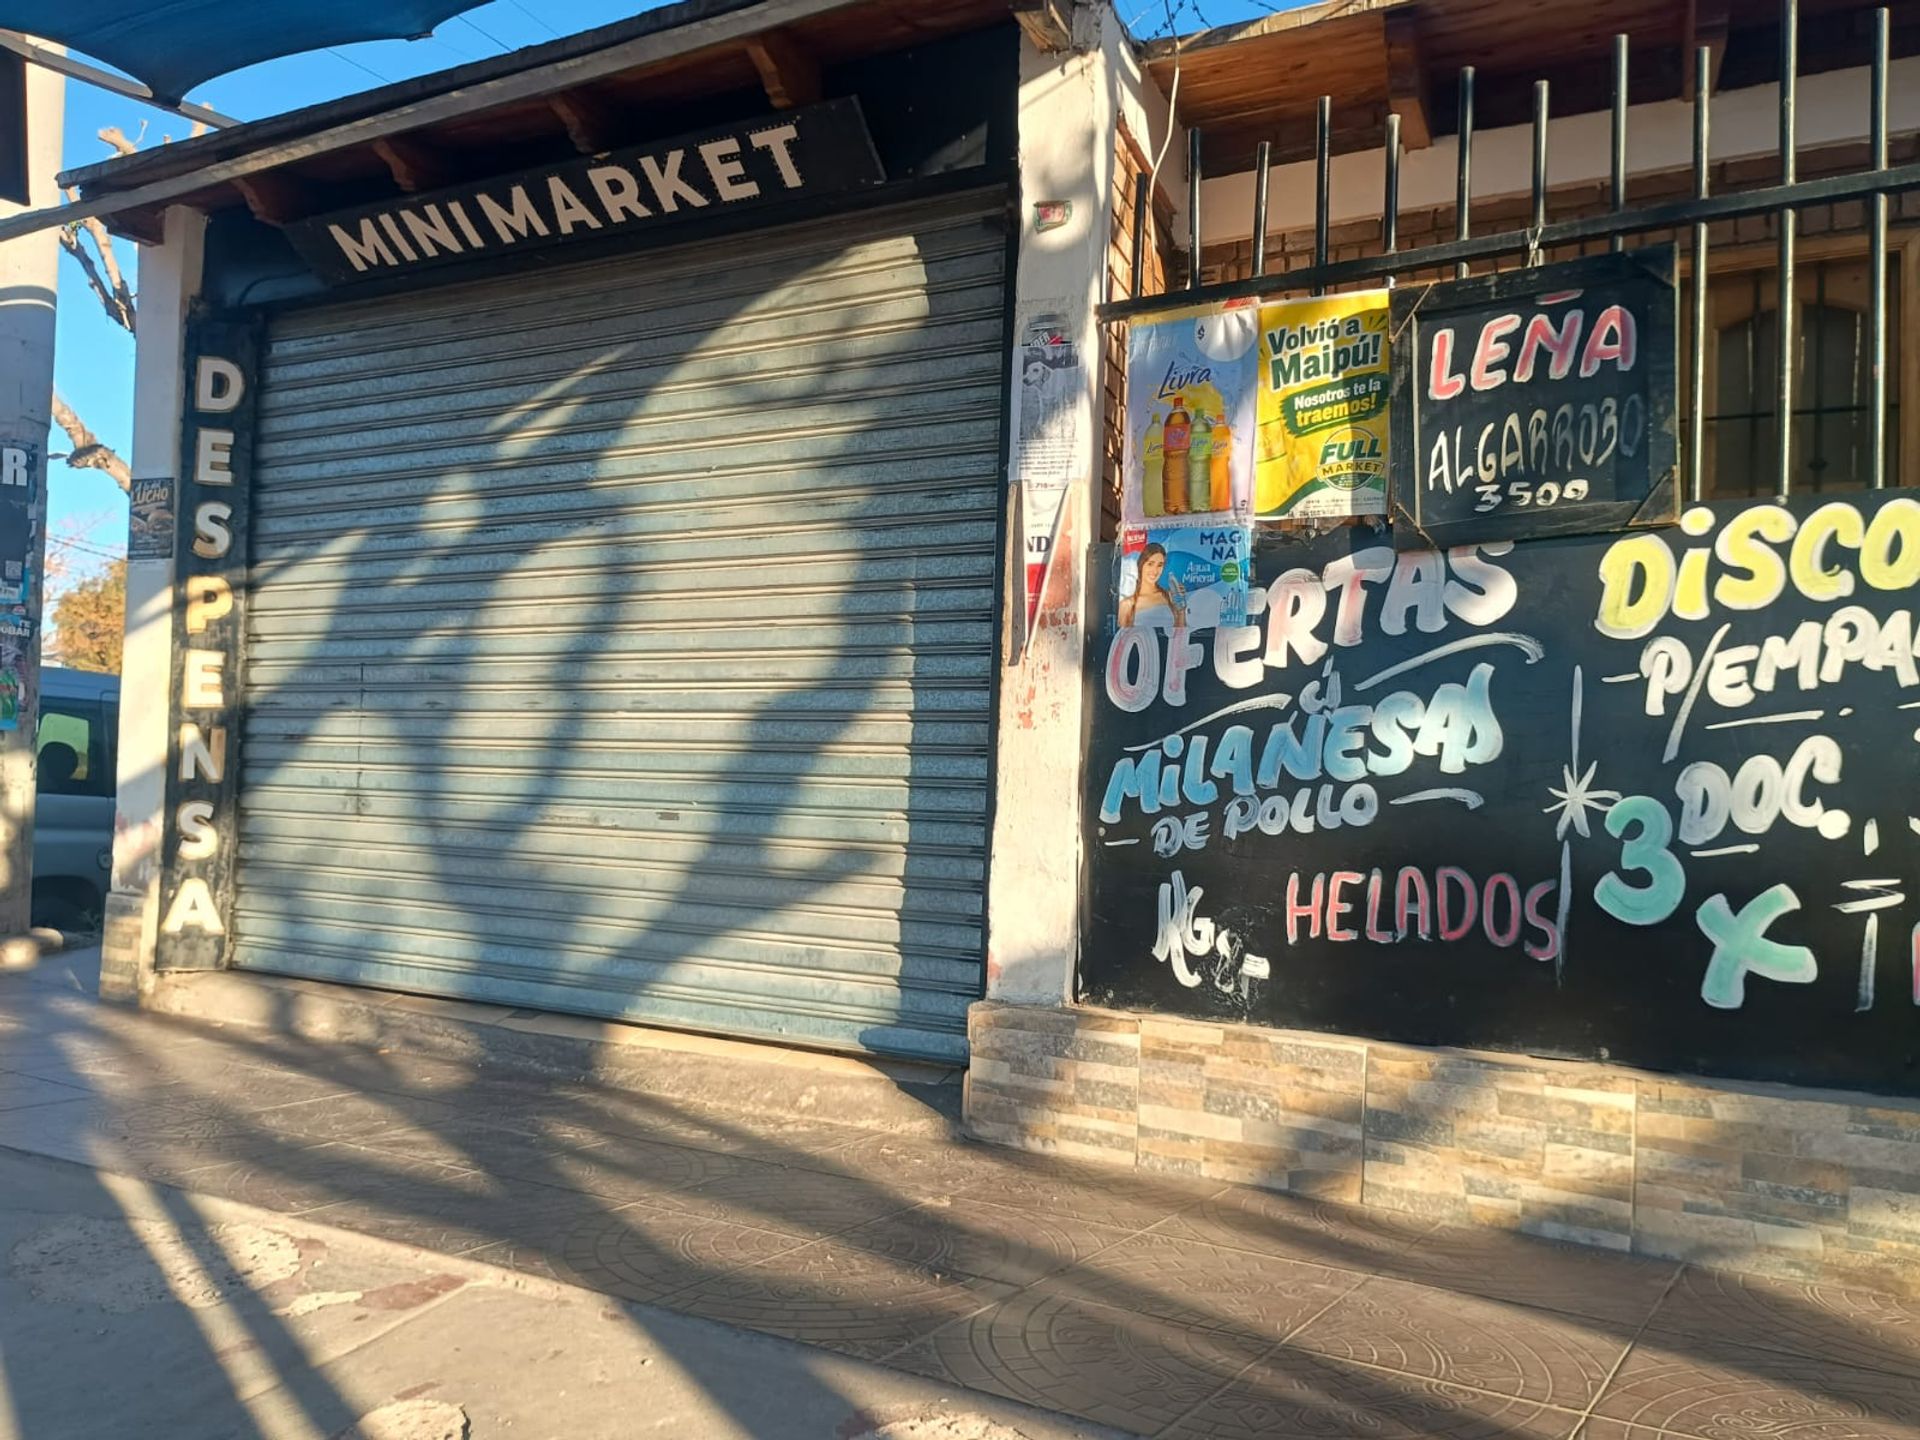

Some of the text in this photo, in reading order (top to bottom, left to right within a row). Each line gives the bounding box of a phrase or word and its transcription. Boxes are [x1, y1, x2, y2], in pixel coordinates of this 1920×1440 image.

[328, 124, 804, 272] MINIMARKET
[1268, 318, 1360, 355] Volvió a
[1429, 288, 1637, 400] LEÑA
[1158, 361, 1212, 399] Livra
[1271, 334, 1381, 391] Maipú!
[1294, 378, 1381, 411] Nosotros te la
[1296, 394, 1376, 428] traemos!
[1319, 438, 1382, 465] FULL
[1322, 462, 1381, 477] MARKET
[1474, 478, 1589, 513] 3500
[1200, 531, 1241, 545] MAG
[1211, 546, 1237, 560] NA
[1182, 572, 1215, 584] Mineral
[1186, 561, 1211, 576] Agua
[160, 355, 246, 934] DESPENSA
[1106, 542, 1517, 713] OFERTAS
[1151, 782, 1379, 858] DE POLLO
[1594, 795, 1686, 926] 3
[1287, 866, 1557, 962] HELADOS
